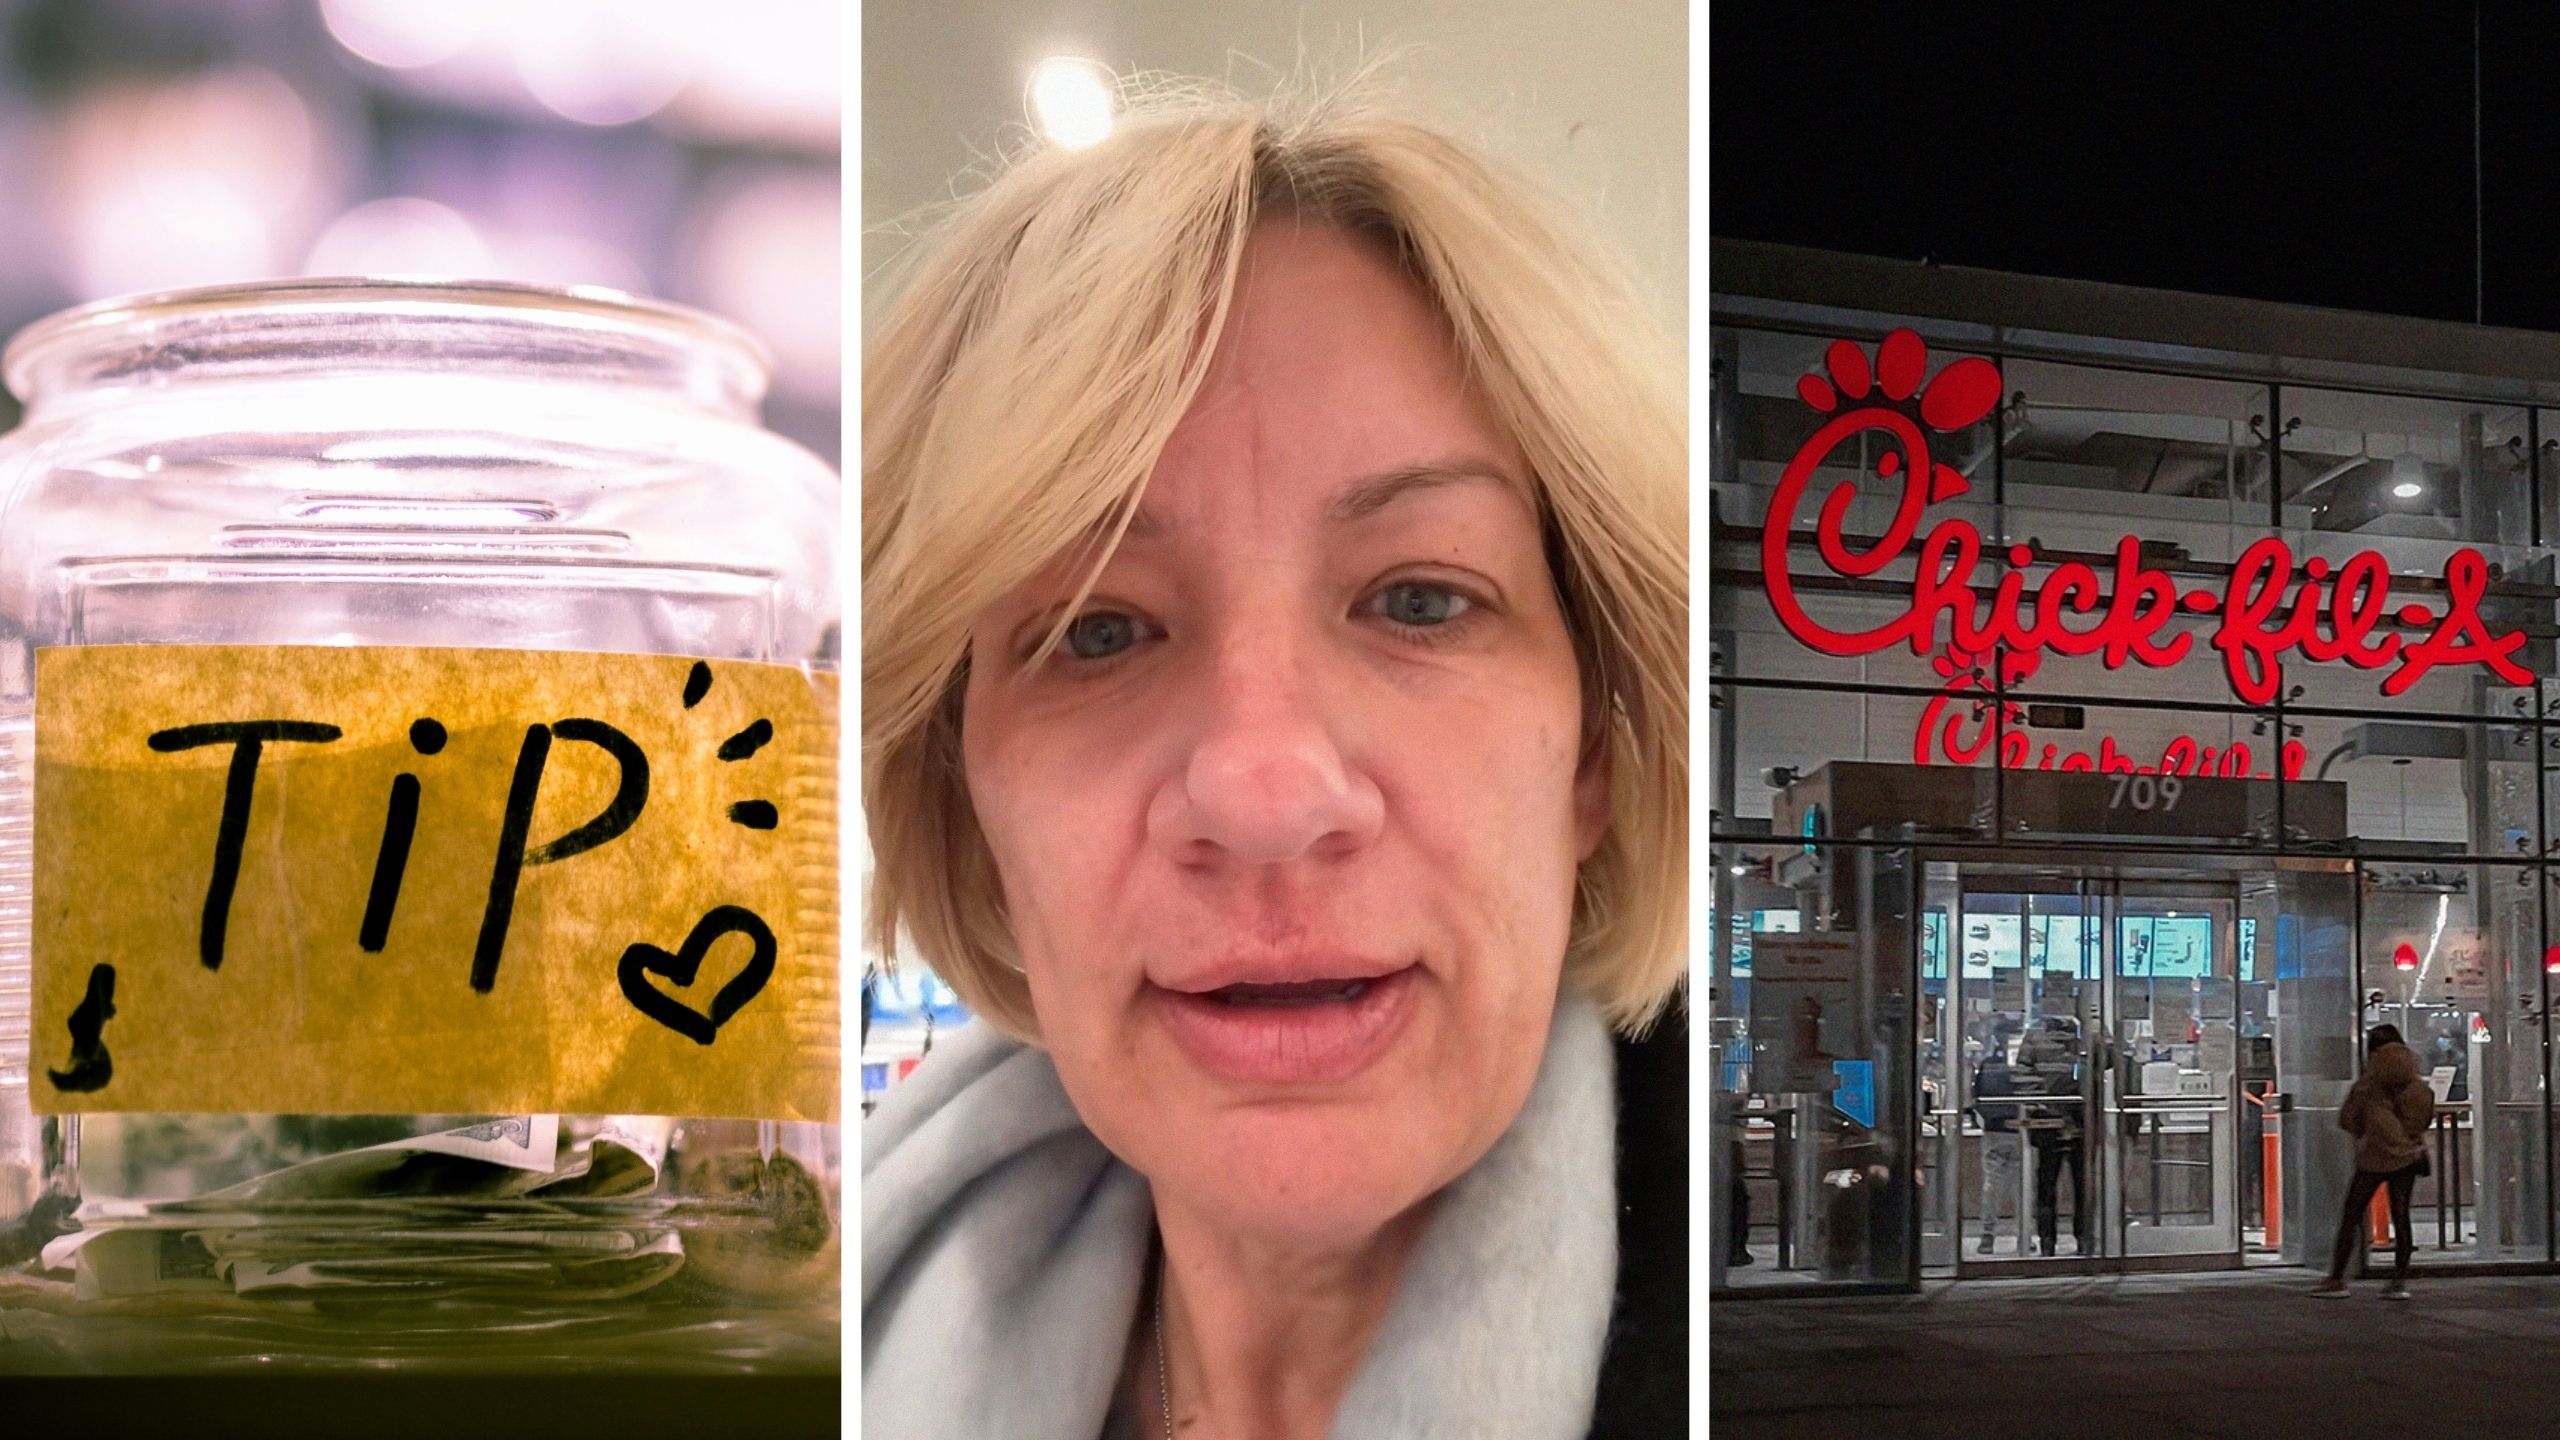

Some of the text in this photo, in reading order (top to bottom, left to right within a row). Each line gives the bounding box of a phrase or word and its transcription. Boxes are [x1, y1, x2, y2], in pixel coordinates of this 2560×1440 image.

[1763, 408, 2535, 706] Chick-fil-A
[148, 718, 650, 995] TiP
[2107, 774, 2183, 811] 709
